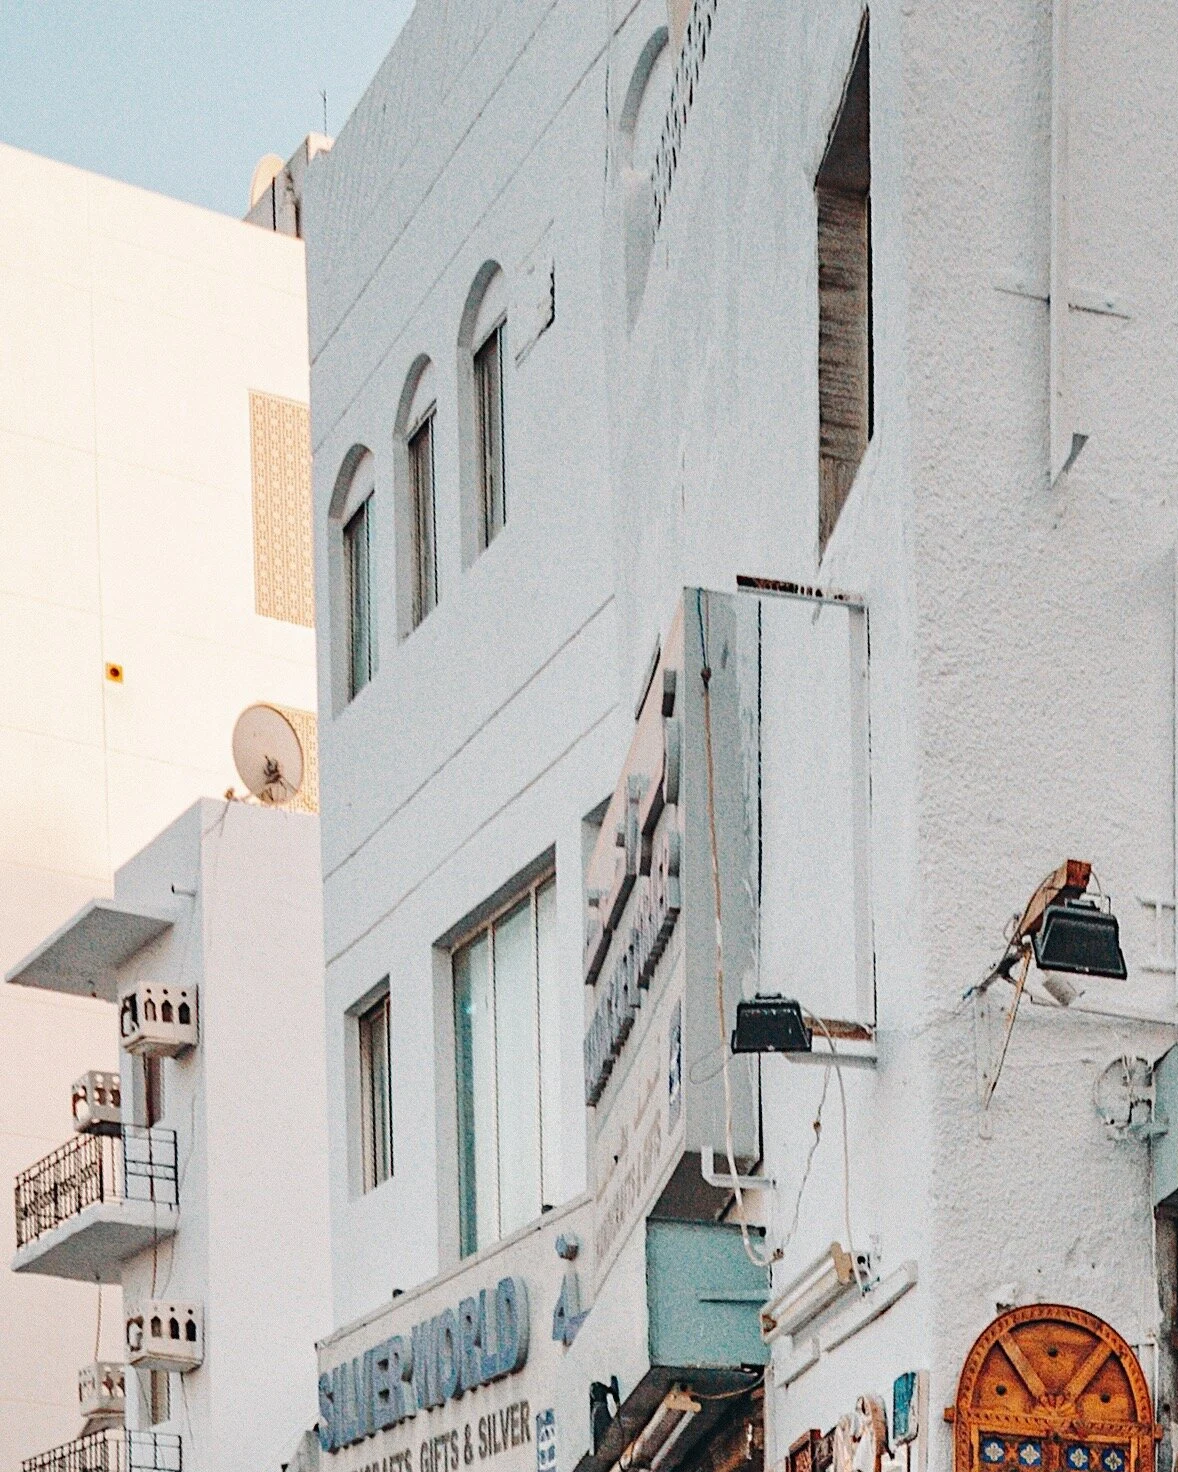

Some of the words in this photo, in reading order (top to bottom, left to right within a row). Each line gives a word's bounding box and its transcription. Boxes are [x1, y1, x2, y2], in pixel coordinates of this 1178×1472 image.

[318, 1334, 411, 1453] SILVER
[411, 1276, 529, 1410] WORLD
[463, 1424, 474, 1466] &
[478, 1401, 531, 1460] SILVER
